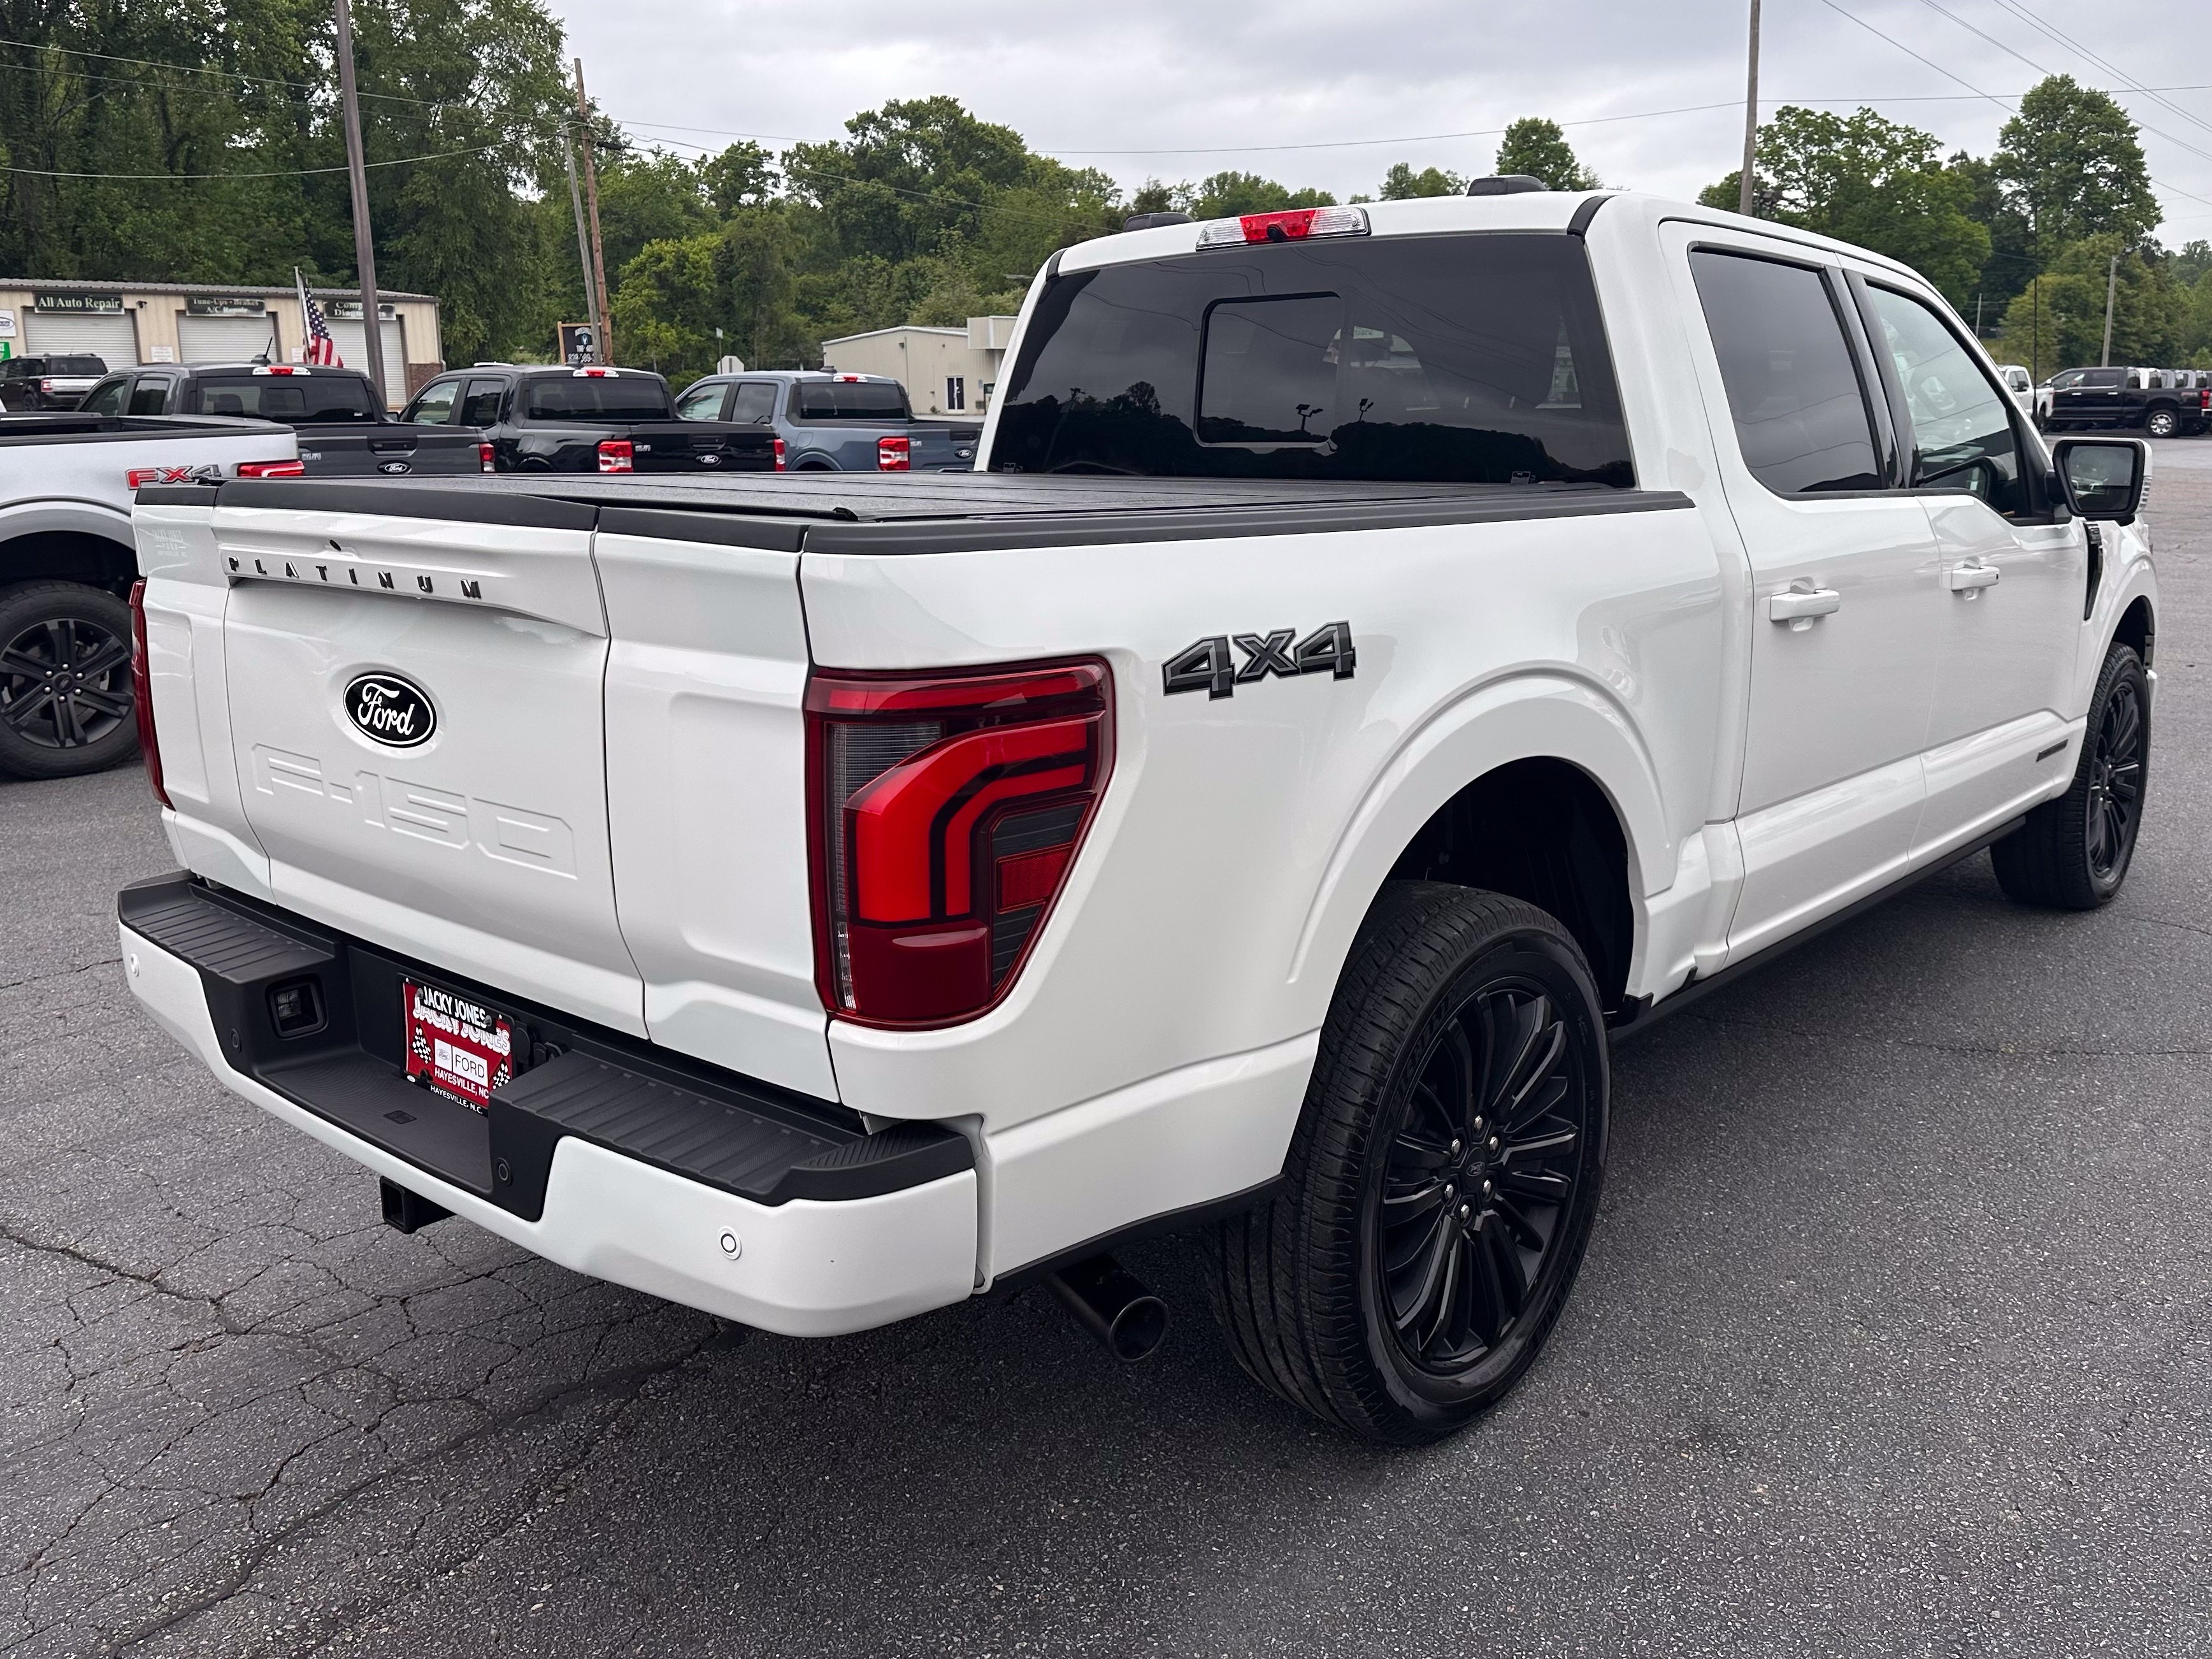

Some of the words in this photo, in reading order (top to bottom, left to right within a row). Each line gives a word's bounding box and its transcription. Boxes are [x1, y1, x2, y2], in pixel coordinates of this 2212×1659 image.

[38, 296, 54, 308] All
[56, 298, 82, 308] Auto
[85, 297, 120, 311] Repair
[126, 464, 222, 490] FX4
[387, 463, 405, 472] Ford
[228, 556, 482, 600] PLATINUM
[357, 682, 416, 736] Ford
[251, 743, 577, 880] F-150
[424, 986, 452, 1015] JACKY
[455, 997, 487, 1028] JONES
[455, 1054, 485, 1079] FORD
[430, 1084, 469, 1108] HAYESVILLE,
[470, 1102, 483, 1115] N.C.
[434, 1067, 478, 1096] HAYESVILLE,
[478, 1087, 489, 1100] NC
